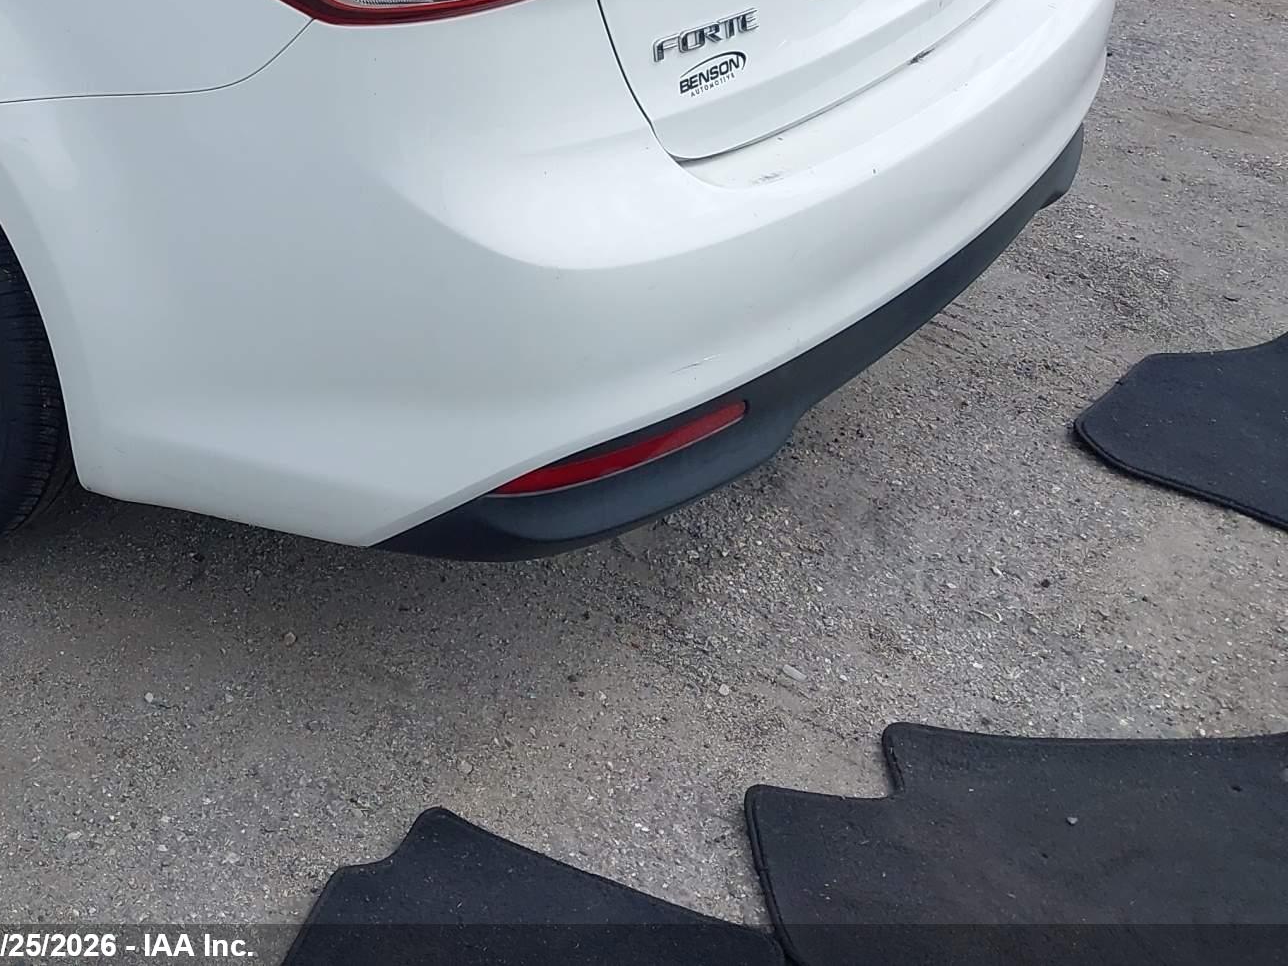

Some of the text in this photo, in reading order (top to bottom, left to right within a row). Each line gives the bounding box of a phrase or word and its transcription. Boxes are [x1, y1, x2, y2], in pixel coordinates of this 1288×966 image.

[653, 7, 759, 62] FORTE
[679, 56, 740, 94] BENSON
[690, 72, 735, 97] AUTOMOTIVE
